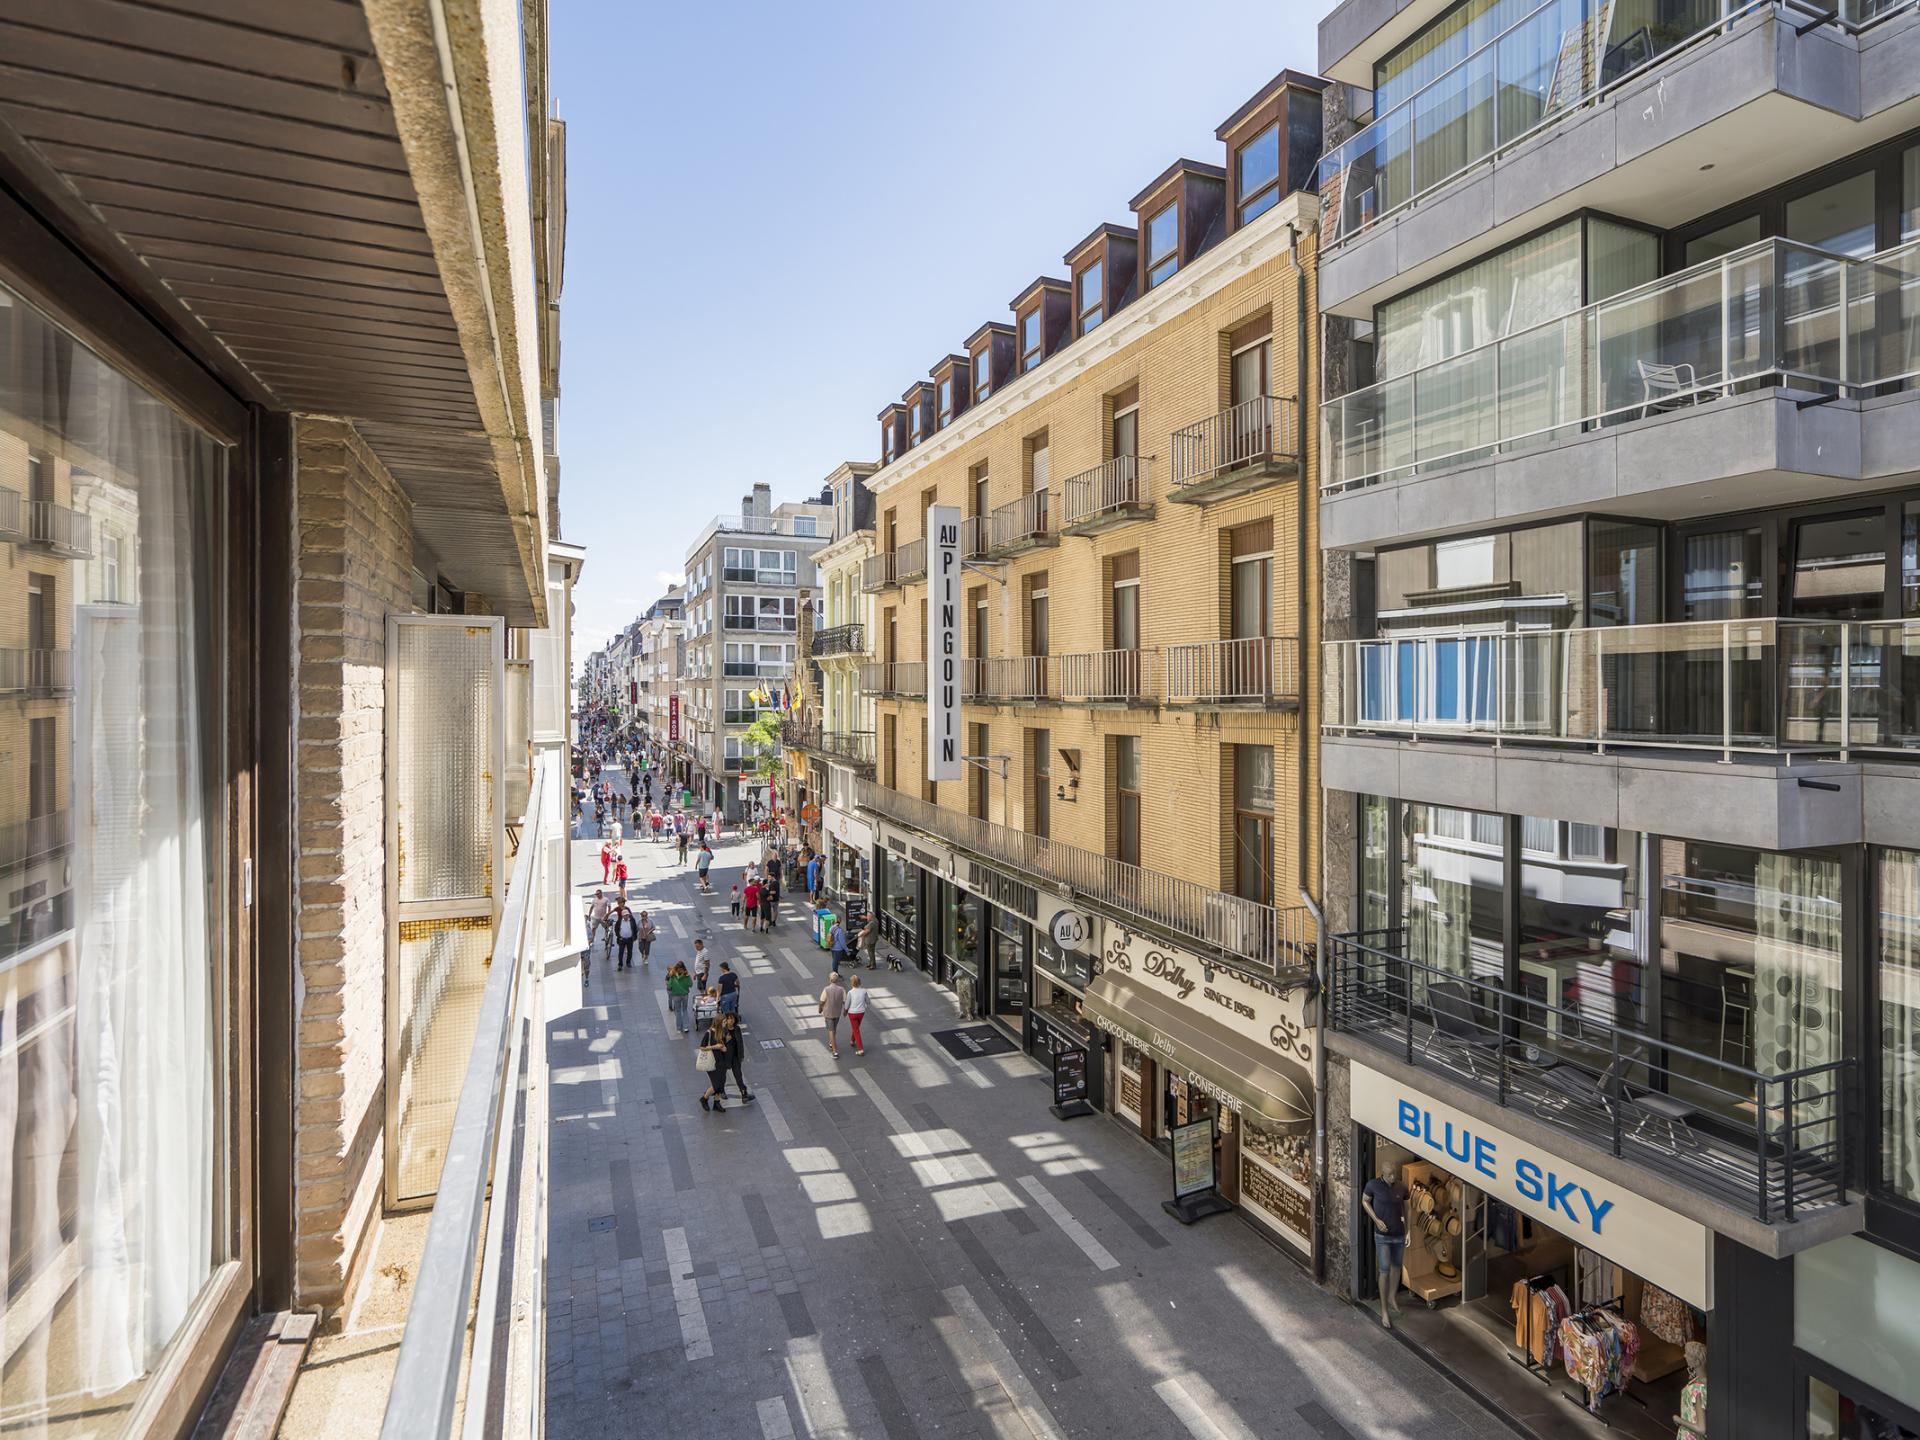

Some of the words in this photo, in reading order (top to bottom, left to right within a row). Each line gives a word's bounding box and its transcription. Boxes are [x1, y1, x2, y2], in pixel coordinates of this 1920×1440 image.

[940, 525, 957, 544] AU
[943, 552, 954, 762] PINGOUIN
[1060, 925, 1071, 938] AU
[1203, 986, 1233, 1010] SINCE
[1097, 1015, 1150, 1056] CHOCOLATERIE
[1188, 1071, 1243, 1114] CONFISERIE
[1398, 1098, 1497, 1180] BLUE
[1515, 1158, 1615, 1235] SKY
